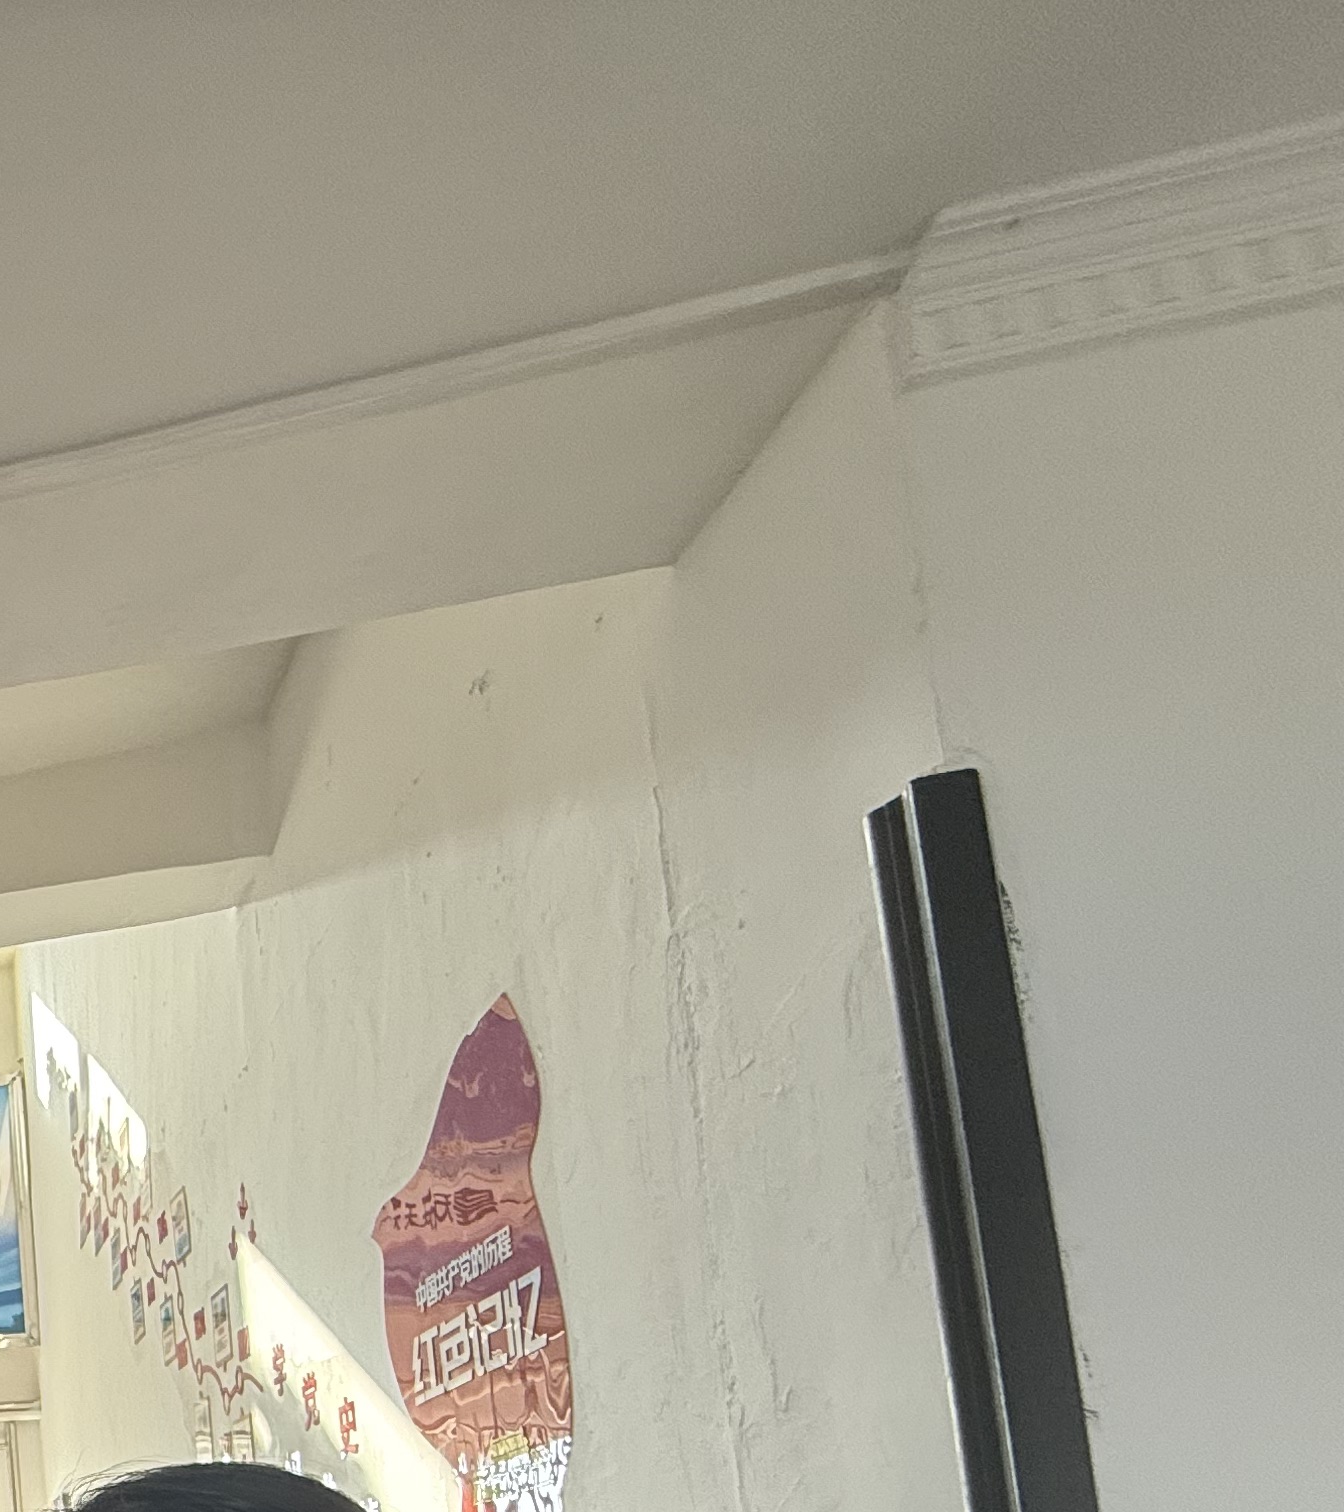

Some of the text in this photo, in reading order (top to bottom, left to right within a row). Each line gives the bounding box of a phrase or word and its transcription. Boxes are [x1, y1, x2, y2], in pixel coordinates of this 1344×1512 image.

[415, 1224, 513, 1312] 中国共产党的历程
[413, 1265, 548, 1407] 红色记忆
[272, 1343, 360, 1460] 学党史
